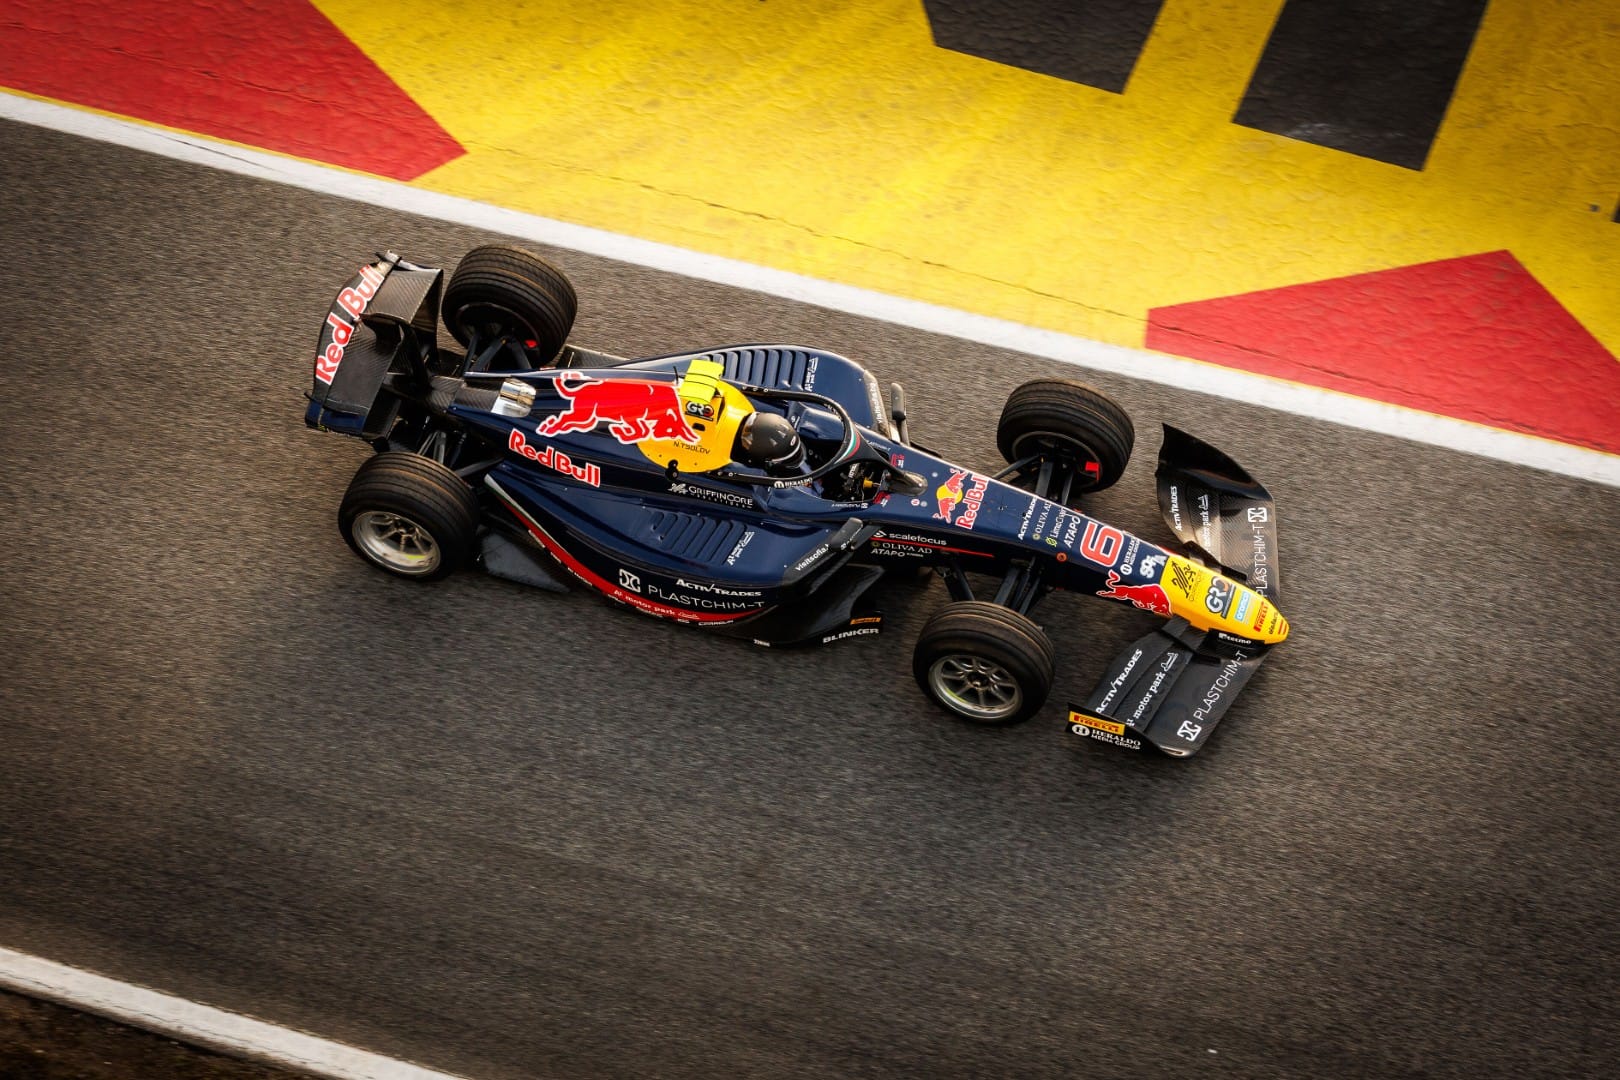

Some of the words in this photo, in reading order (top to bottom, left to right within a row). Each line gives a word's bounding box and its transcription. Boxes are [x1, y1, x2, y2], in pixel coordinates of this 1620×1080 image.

[315, 312, 354, 385] Red
[337, 264, 384, 320] Bull
[508, 428, 554, 475] Red
[554, 449, 600, 487] Bull
[688, 483, 753, 505] GRIFFINCORE
[967, 473, 990, 507] Bull
[955, 494, 982, 530] Red
[1018, 497, 1038, 540] ACTIVTRADE
[1034, 511, 1049, 534] OLIVA
[1168, 486, 1183, 532] ACTIVTRADES
[882, 542, 915, 552] OLIVA
[918, 546, 932, 554] AD
[889, 532, 947, 546] scalefocus
[1064, 515, 1081, 548] ATAPO
[1080, 520, 1124, 567] 6
[795, 543, 829, 572] visitsofia.
[871, 548, 905, 557] ATAPO
[1254, 524, 1268, 598] PLASTCHIM-T
[649, 585, 764, 609] PLASTCHIM-T
[676, 578, 762, 597] ACTIVTRADES
[654, 606, 676, 617] park
[823, 628, 879, 644] BLINKER
[1096, 649, 1143, 714] ACTIVTRADES
[1133, 691, 1152, 720] motor
[1150, 671, 1166, 694] park
[1193, 650, 1248, 721] PLASTCHIM-T
[1092, 729, 1141, 747] HERALDO
